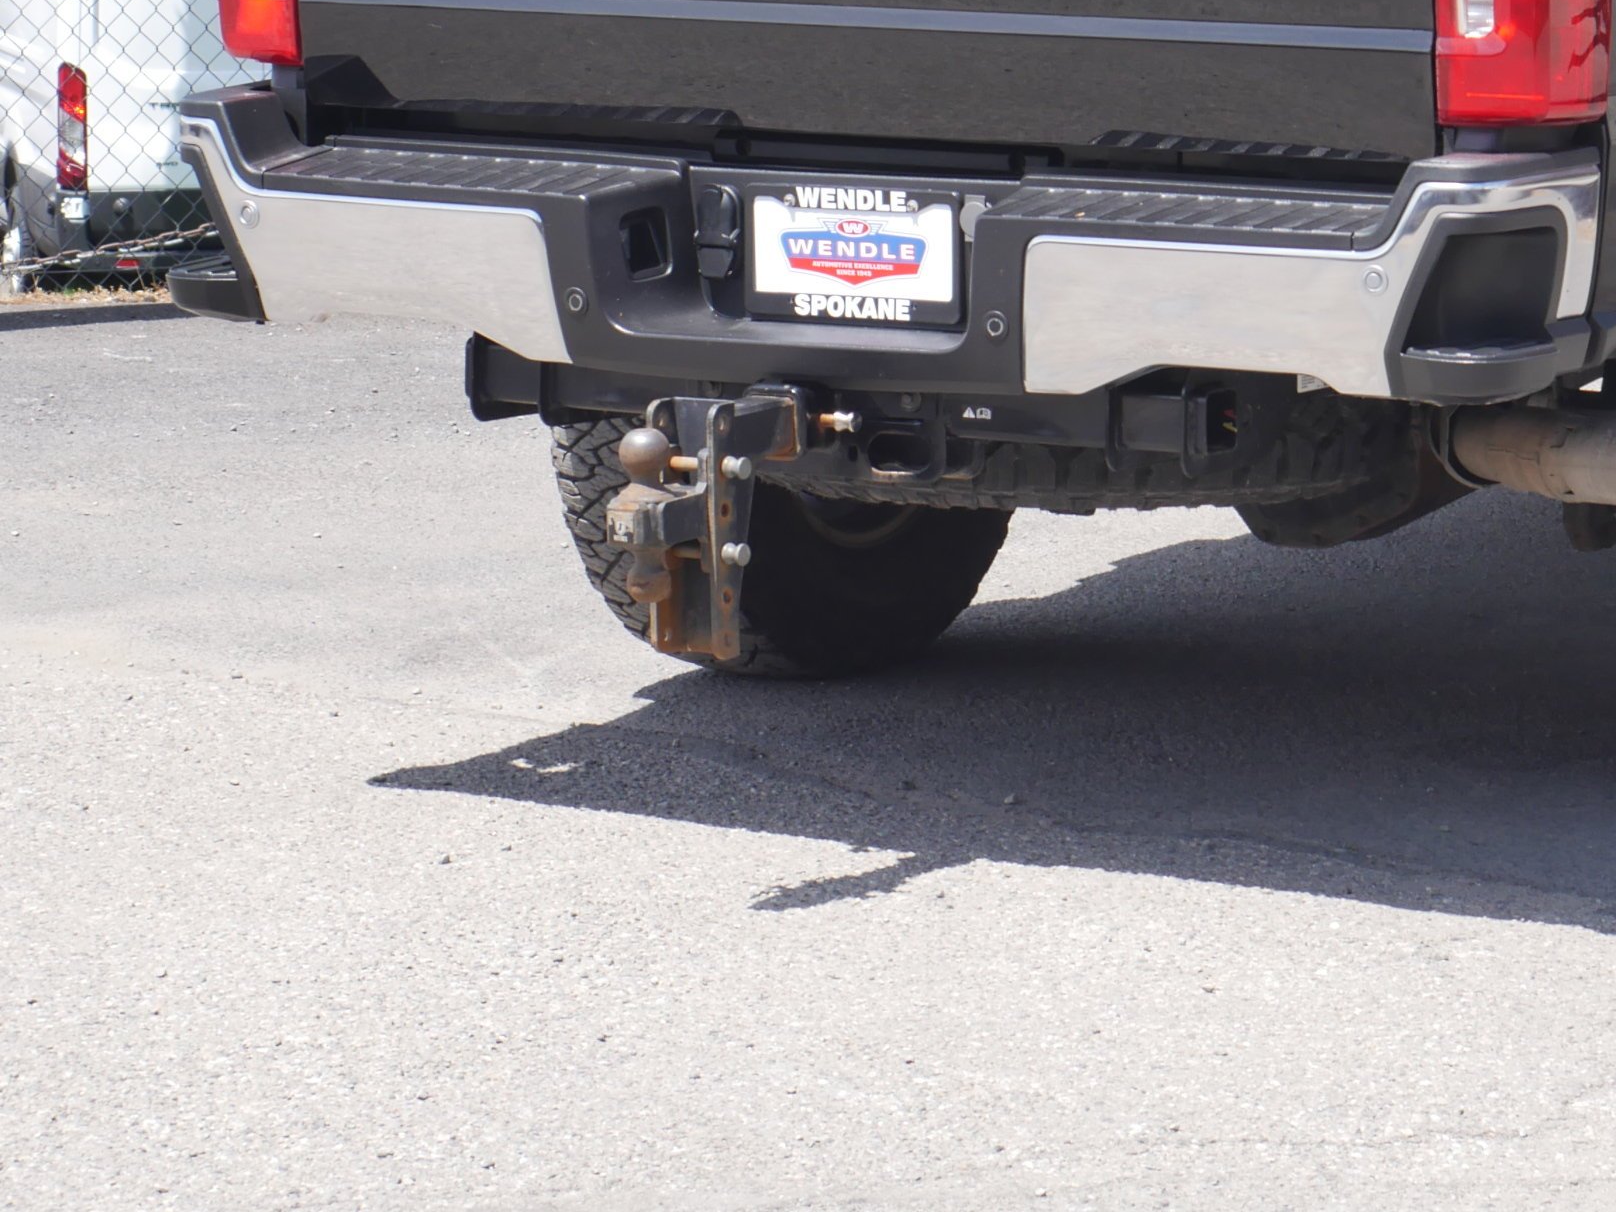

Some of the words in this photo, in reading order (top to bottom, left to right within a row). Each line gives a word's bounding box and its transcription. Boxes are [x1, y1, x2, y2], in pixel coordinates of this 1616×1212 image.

[796, 186, 907, 212] WENDLE
[788, 238, 915, 260] WENDLE
[812, 260, 853, 269] AUTOMOTIVE
[853, 262, 894, 271] EXCELLENCE
[794, 294, 910, 321] SPOKANE
